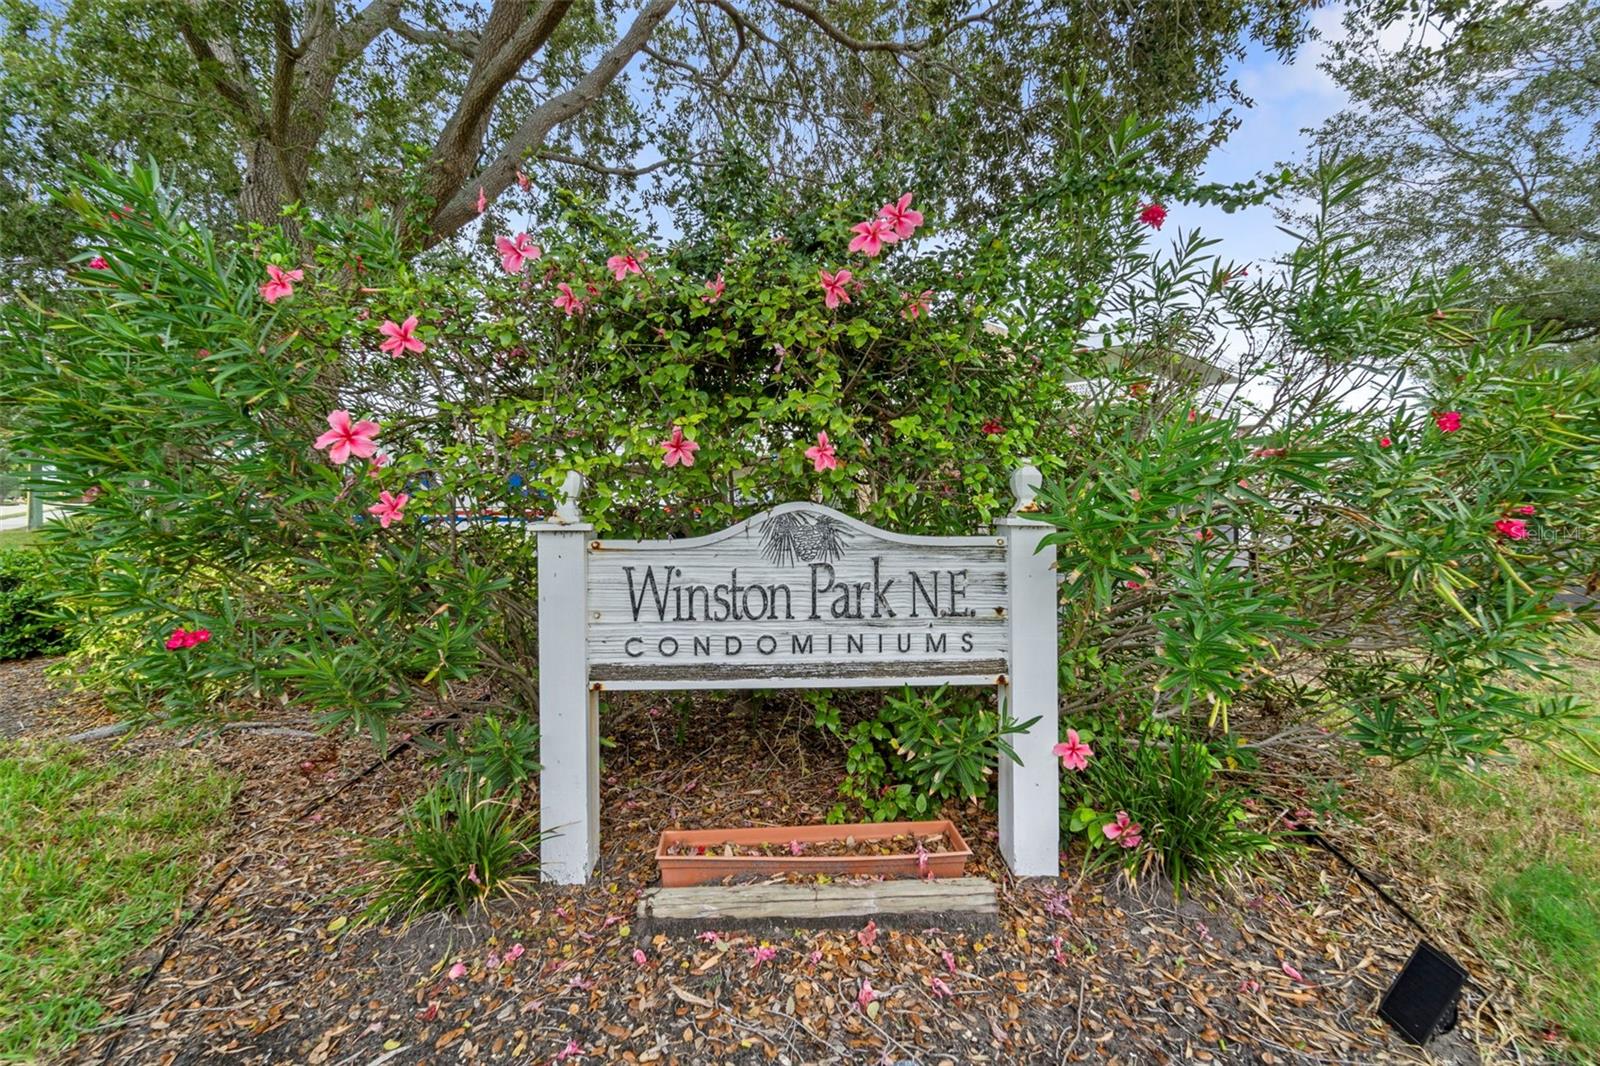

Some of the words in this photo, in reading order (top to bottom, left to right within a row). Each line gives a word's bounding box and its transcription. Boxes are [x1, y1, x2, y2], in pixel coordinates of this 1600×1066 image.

[622, 565, 795, 622] Winston
[808, 556, 897, 619] Park
[624, 632, 974, 658] CONDOMINIUMS
